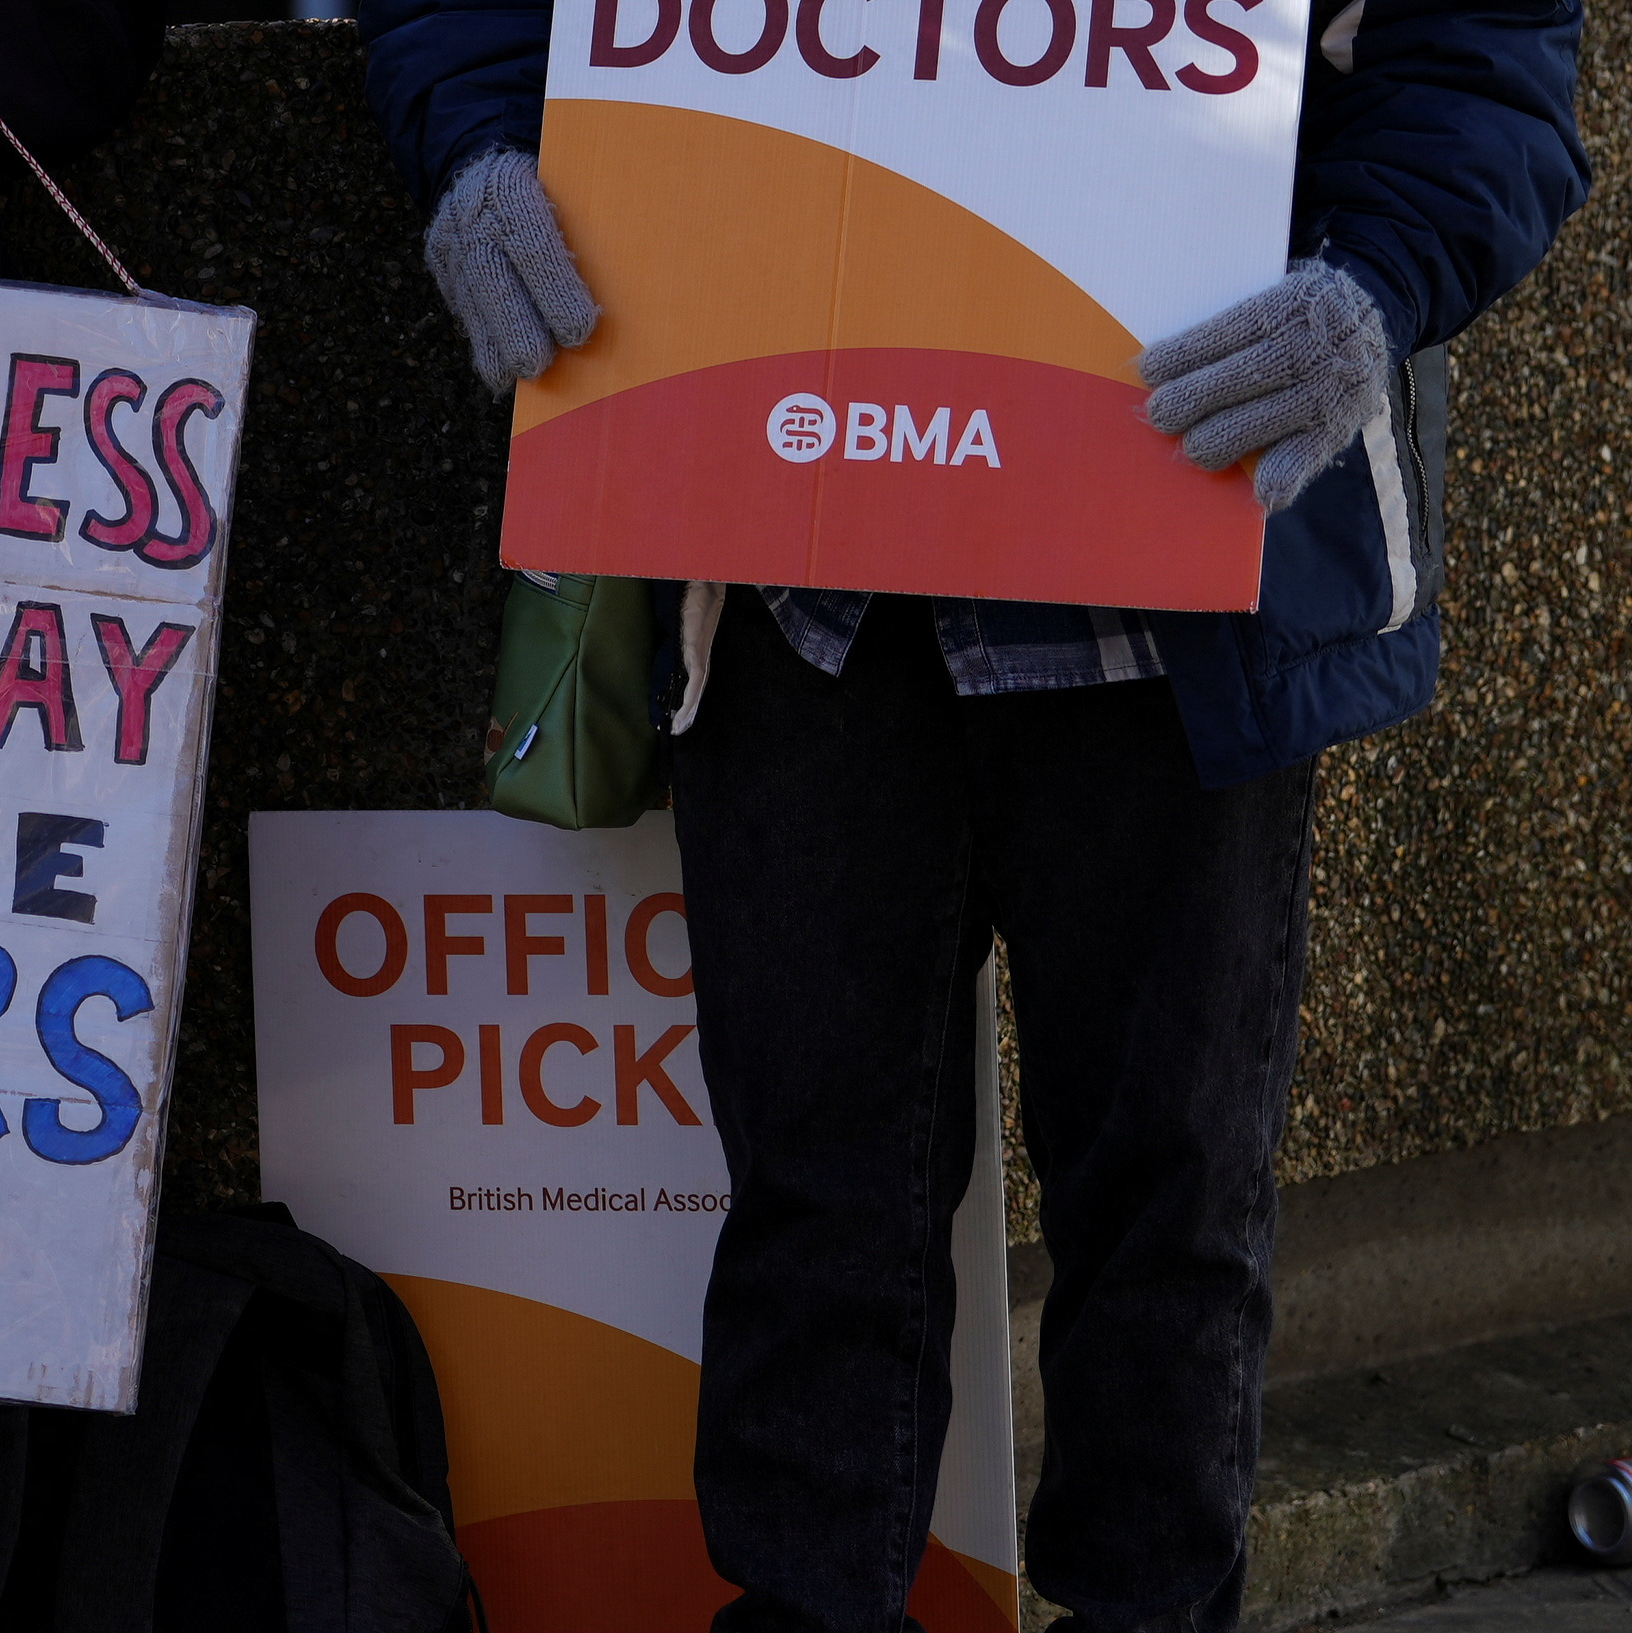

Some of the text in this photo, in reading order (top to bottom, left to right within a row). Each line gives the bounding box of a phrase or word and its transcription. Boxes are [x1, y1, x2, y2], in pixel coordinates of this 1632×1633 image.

[842, 402, 1001, 469] BMA
[314, 892, 696, 998] OFFIC
[390, 1022, 716, 1128] PICK
[449, 1186, 533, 1211] British
[542, 1187, 645, 1211] Medical
